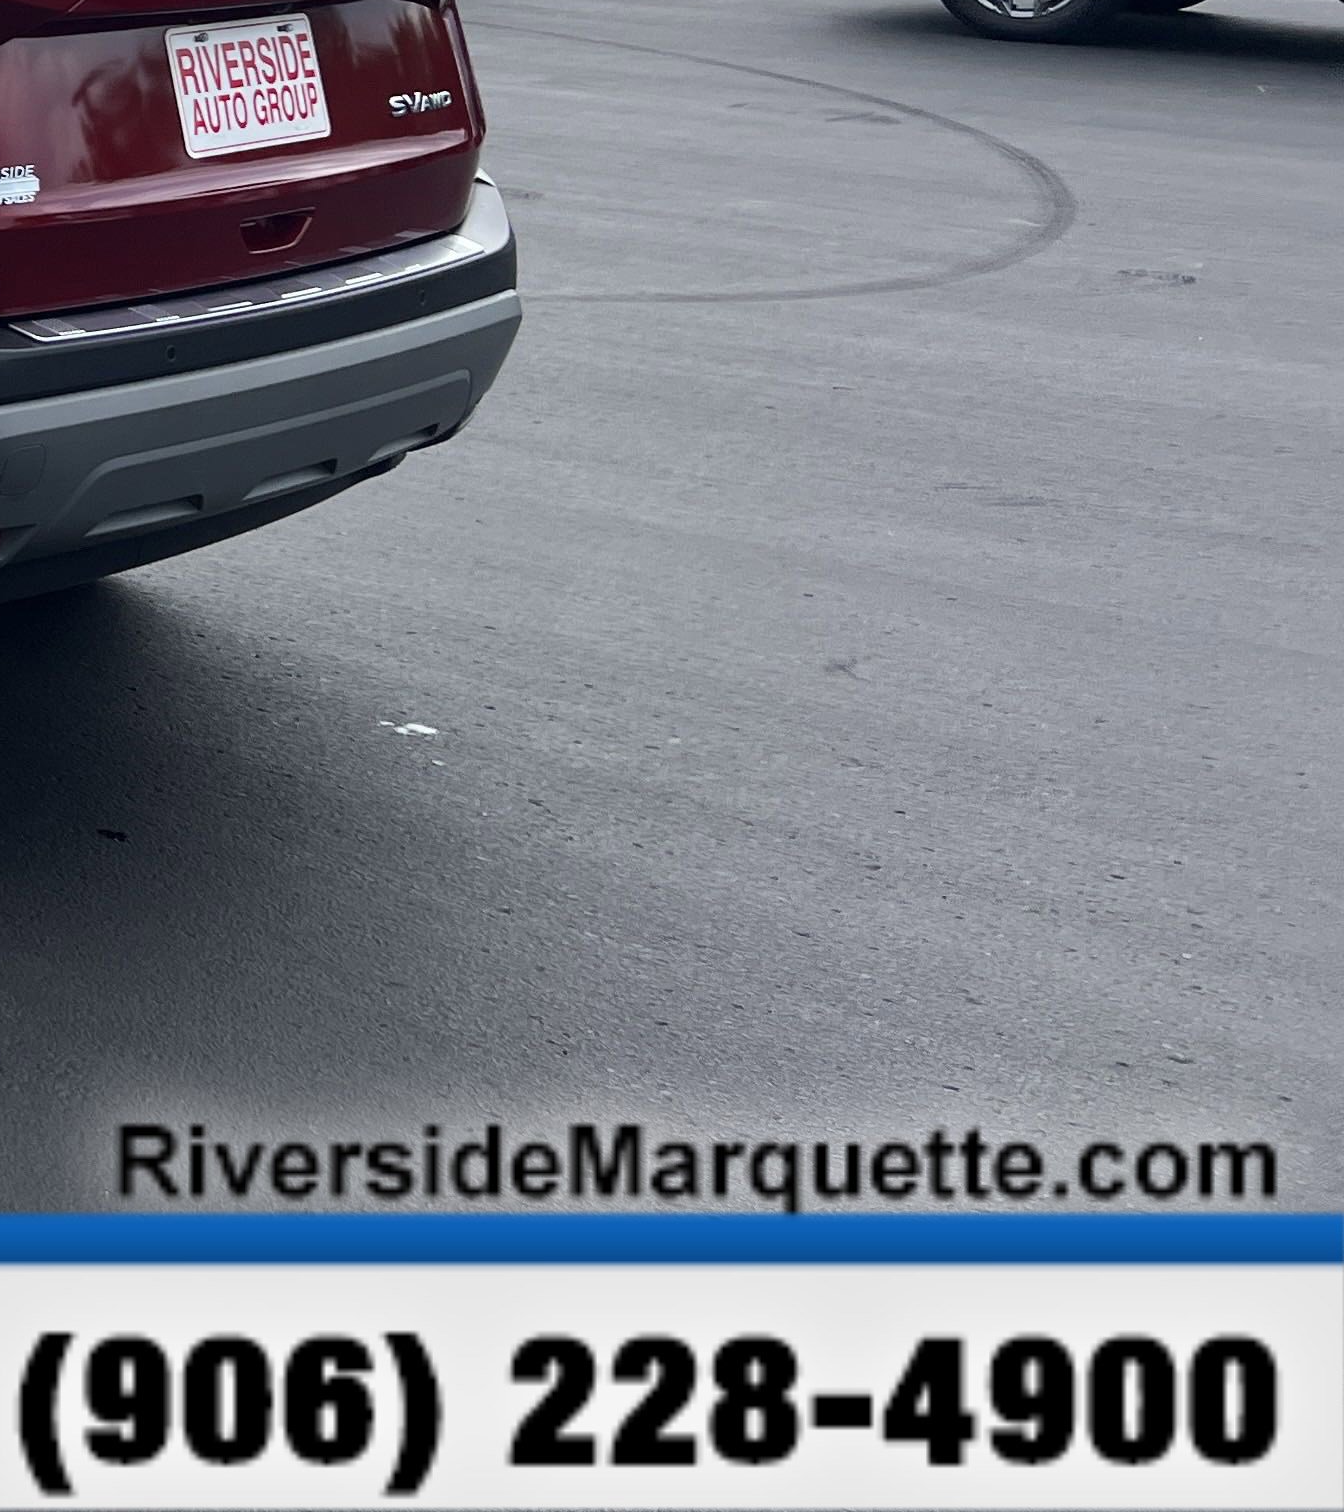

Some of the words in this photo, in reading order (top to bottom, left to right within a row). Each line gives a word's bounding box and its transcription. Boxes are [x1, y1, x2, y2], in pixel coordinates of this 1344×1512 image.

[174, 32, 316, 96] RIVERSIDE
[192, 90, 248, 136] AUTO
[252, 82, 319, 127] GROUP
[3, 192, 35, 204] SALES
